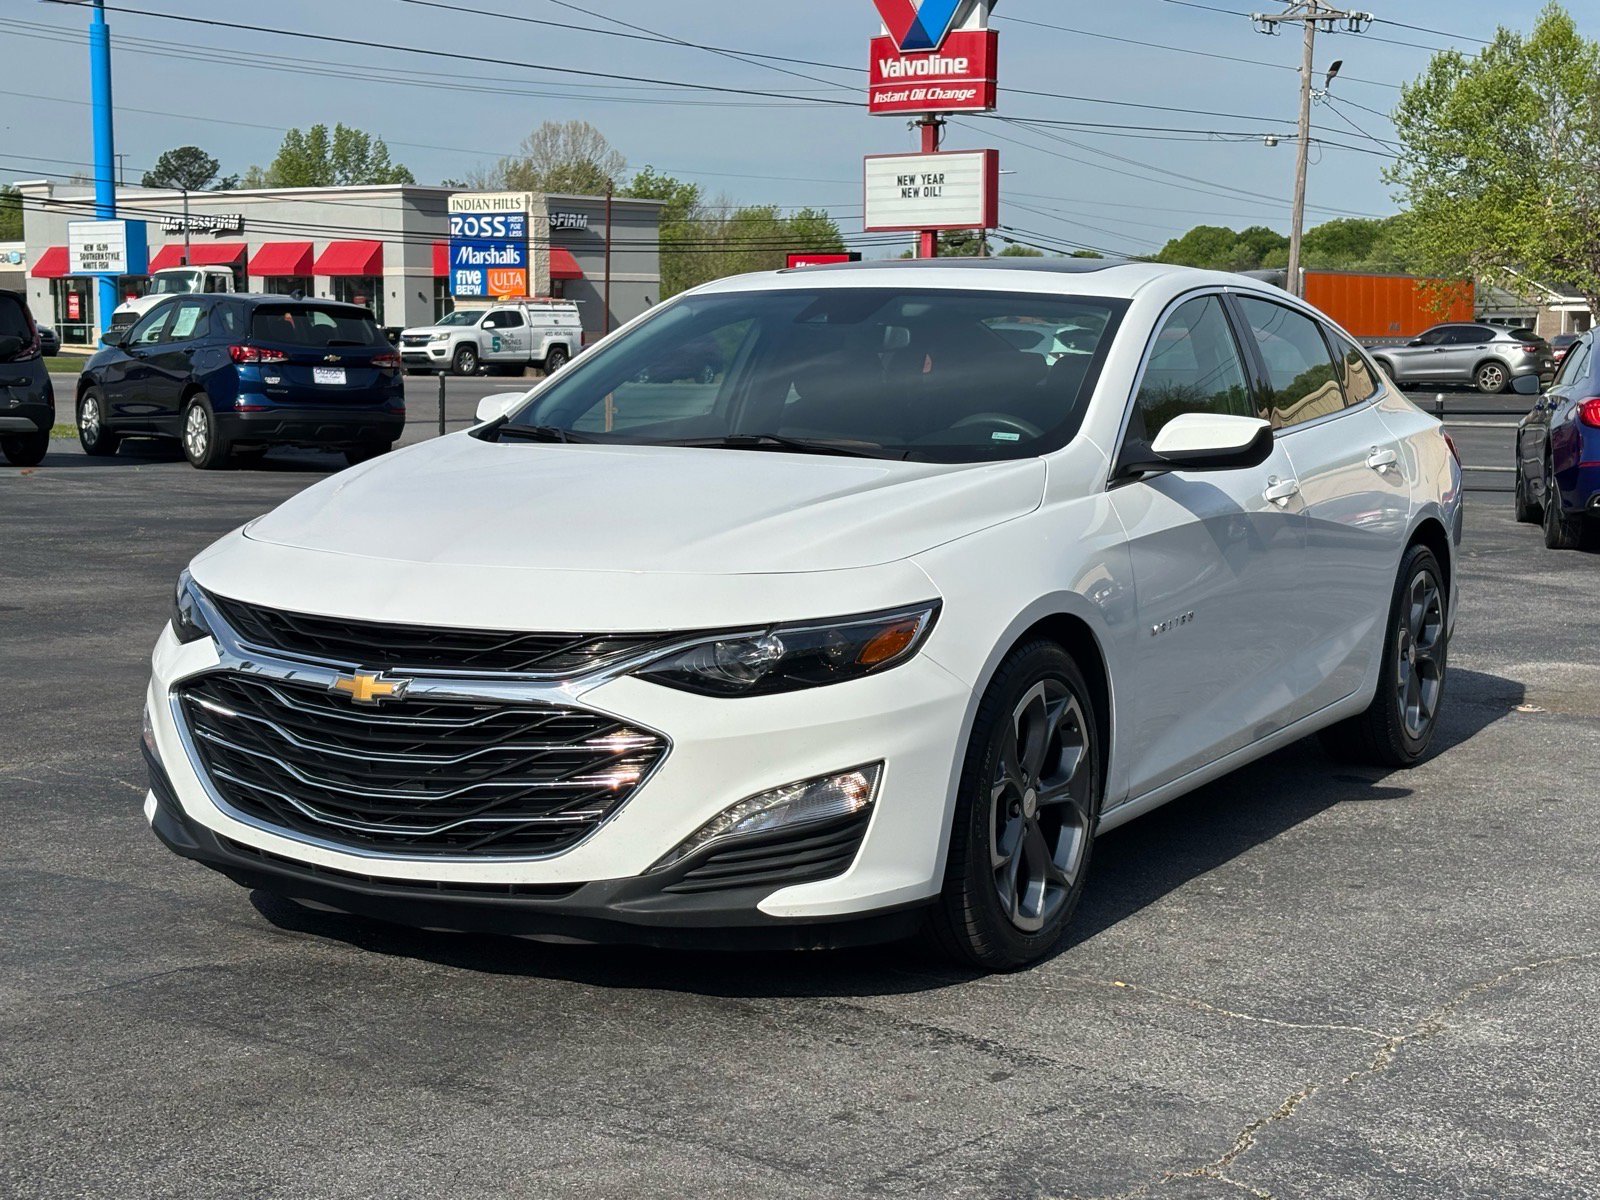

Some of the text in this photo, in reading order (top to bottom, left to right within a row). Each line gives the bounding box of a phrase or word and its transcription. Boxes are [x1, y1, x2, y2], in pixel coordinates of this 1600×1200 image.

[879, 54, 968, 78] Valvoline
[874, 87, 976, 104] Instant Oil Change
[897, 174, 944, 186] NEW YEAR
[901, 186, 942, 198] NEW OIL!
[452, 198, 521, 211] INDIAN HILLS
[451, 216, 506, 237] ROSS
[80, 252, 120, 261] SOUTHERN STYLE
[456, 245, 520, 265] Marshalls
[83, 261, 109, 269] WHITE FISH
[456, 270, 481, 285] five
[494, 272, 523, 286] ULTA
[456, 284, 481, 295] BELOW
[492, 336, 501, 352] 5
